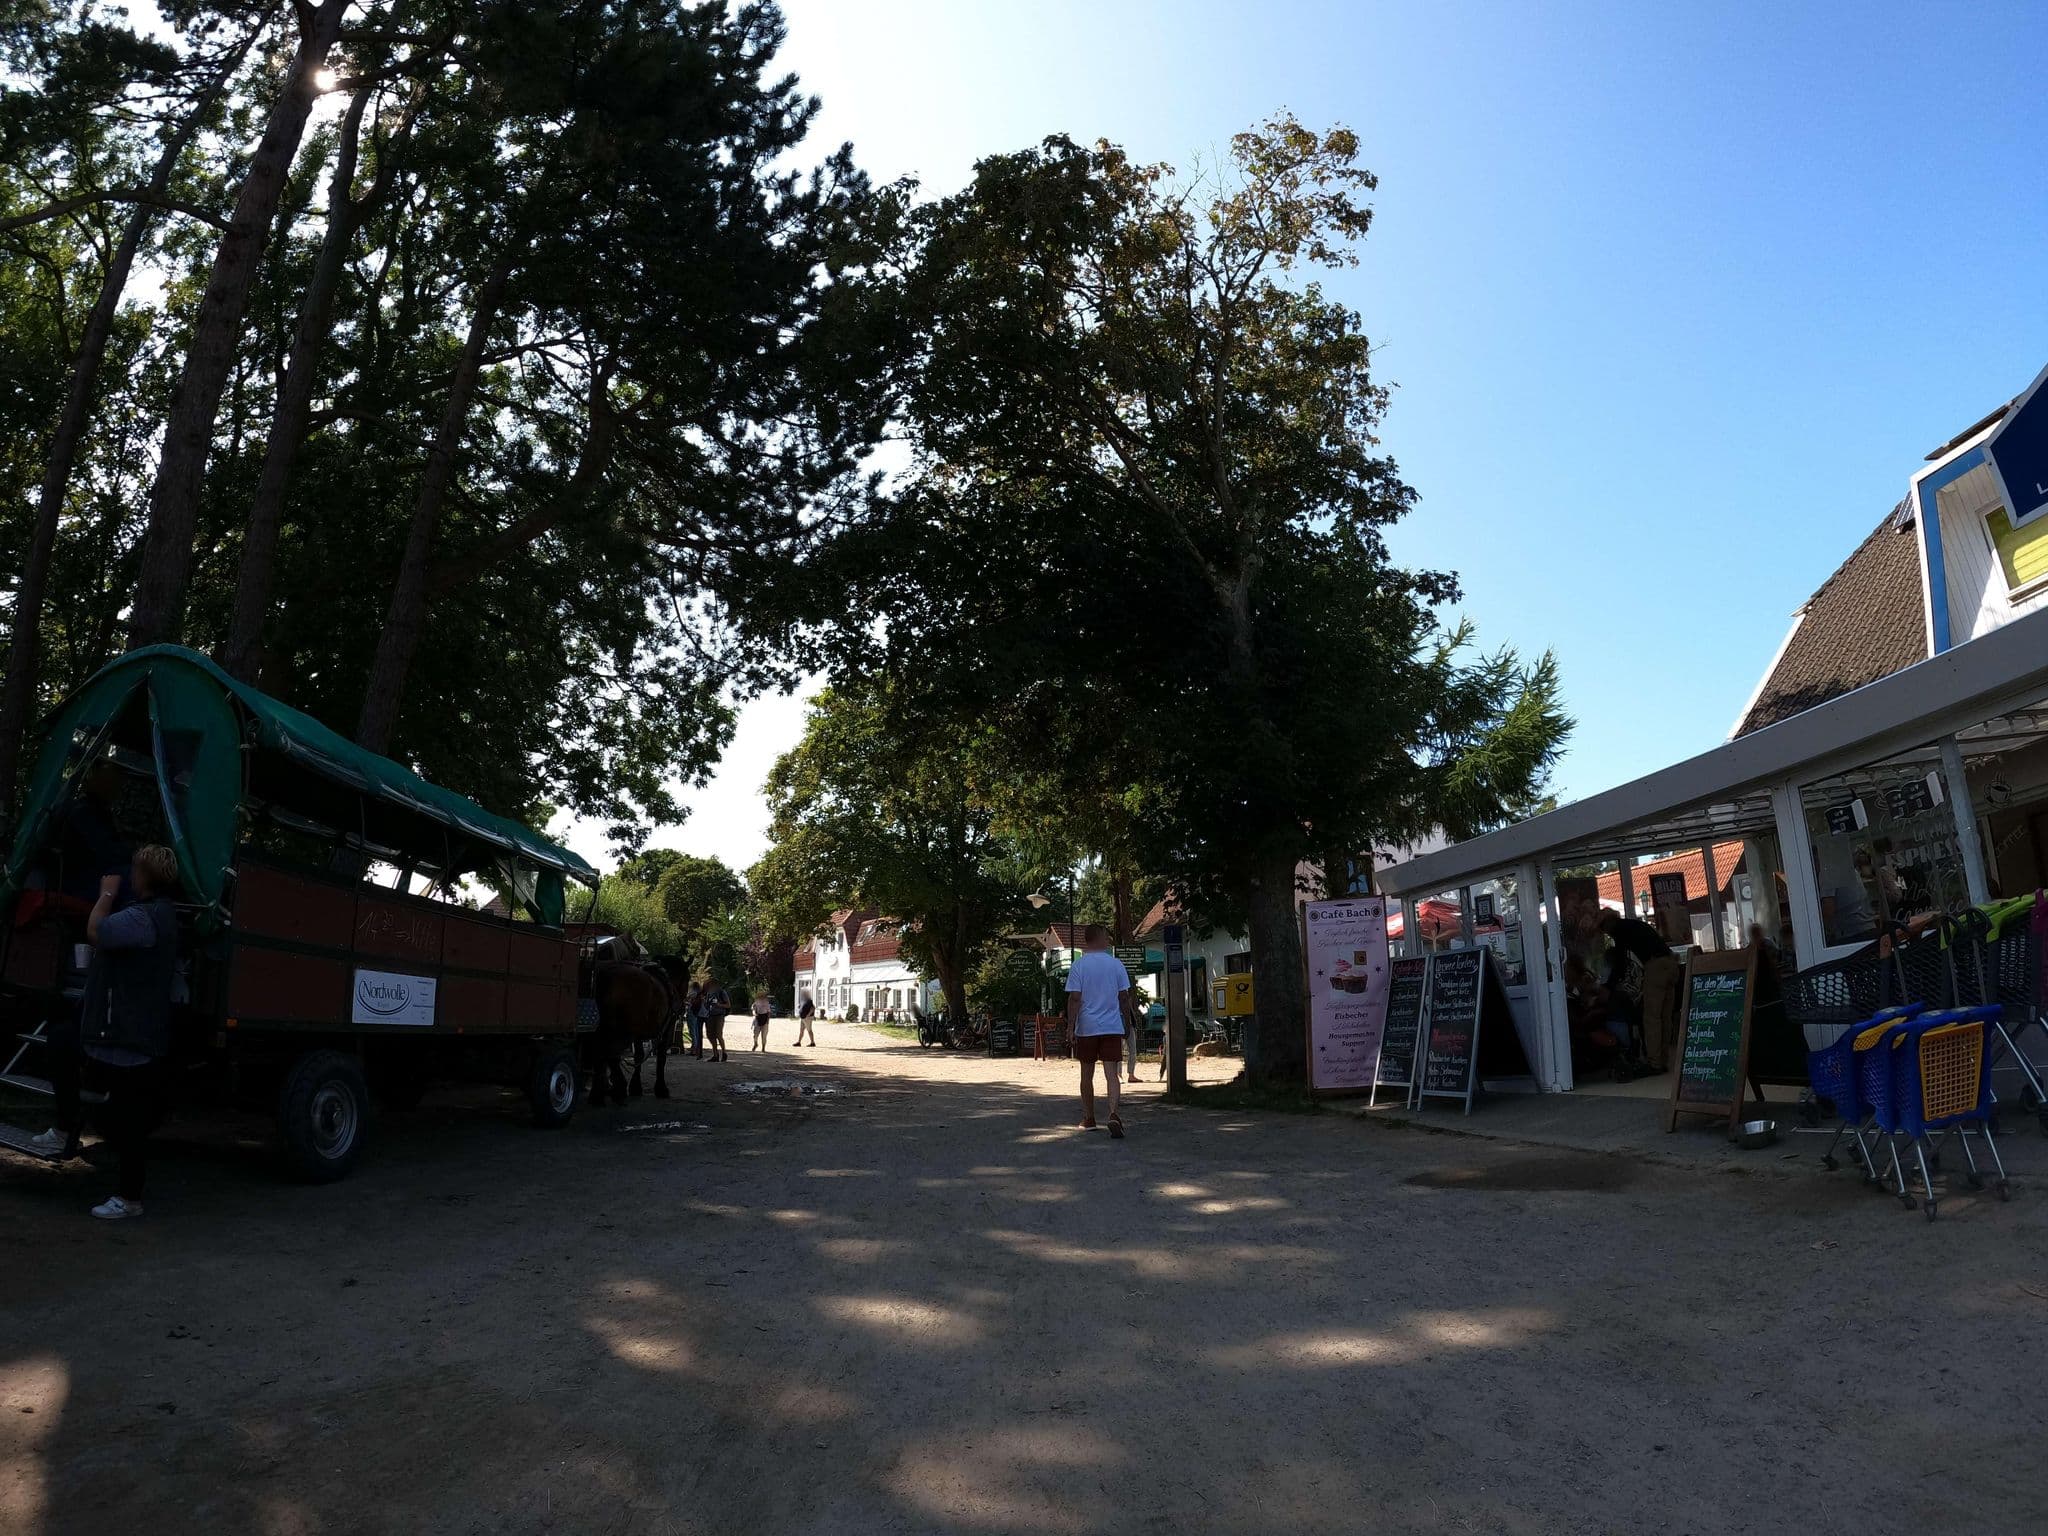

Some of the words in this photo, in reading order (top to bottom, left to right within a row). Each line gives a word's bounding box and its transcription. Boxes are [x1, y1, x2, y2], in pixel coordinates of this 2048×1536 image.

[1320, 909, 1345, 920] Café
[1346, 907, 1371, 918] Bach
[1704, 976, 1717, 989] den
[362, 979, 406, 1001] Nordwolle
[1334, 1011, 1369, 1020] Eisbecher
[1687, 1024, 1715, 1044] Soljanka
